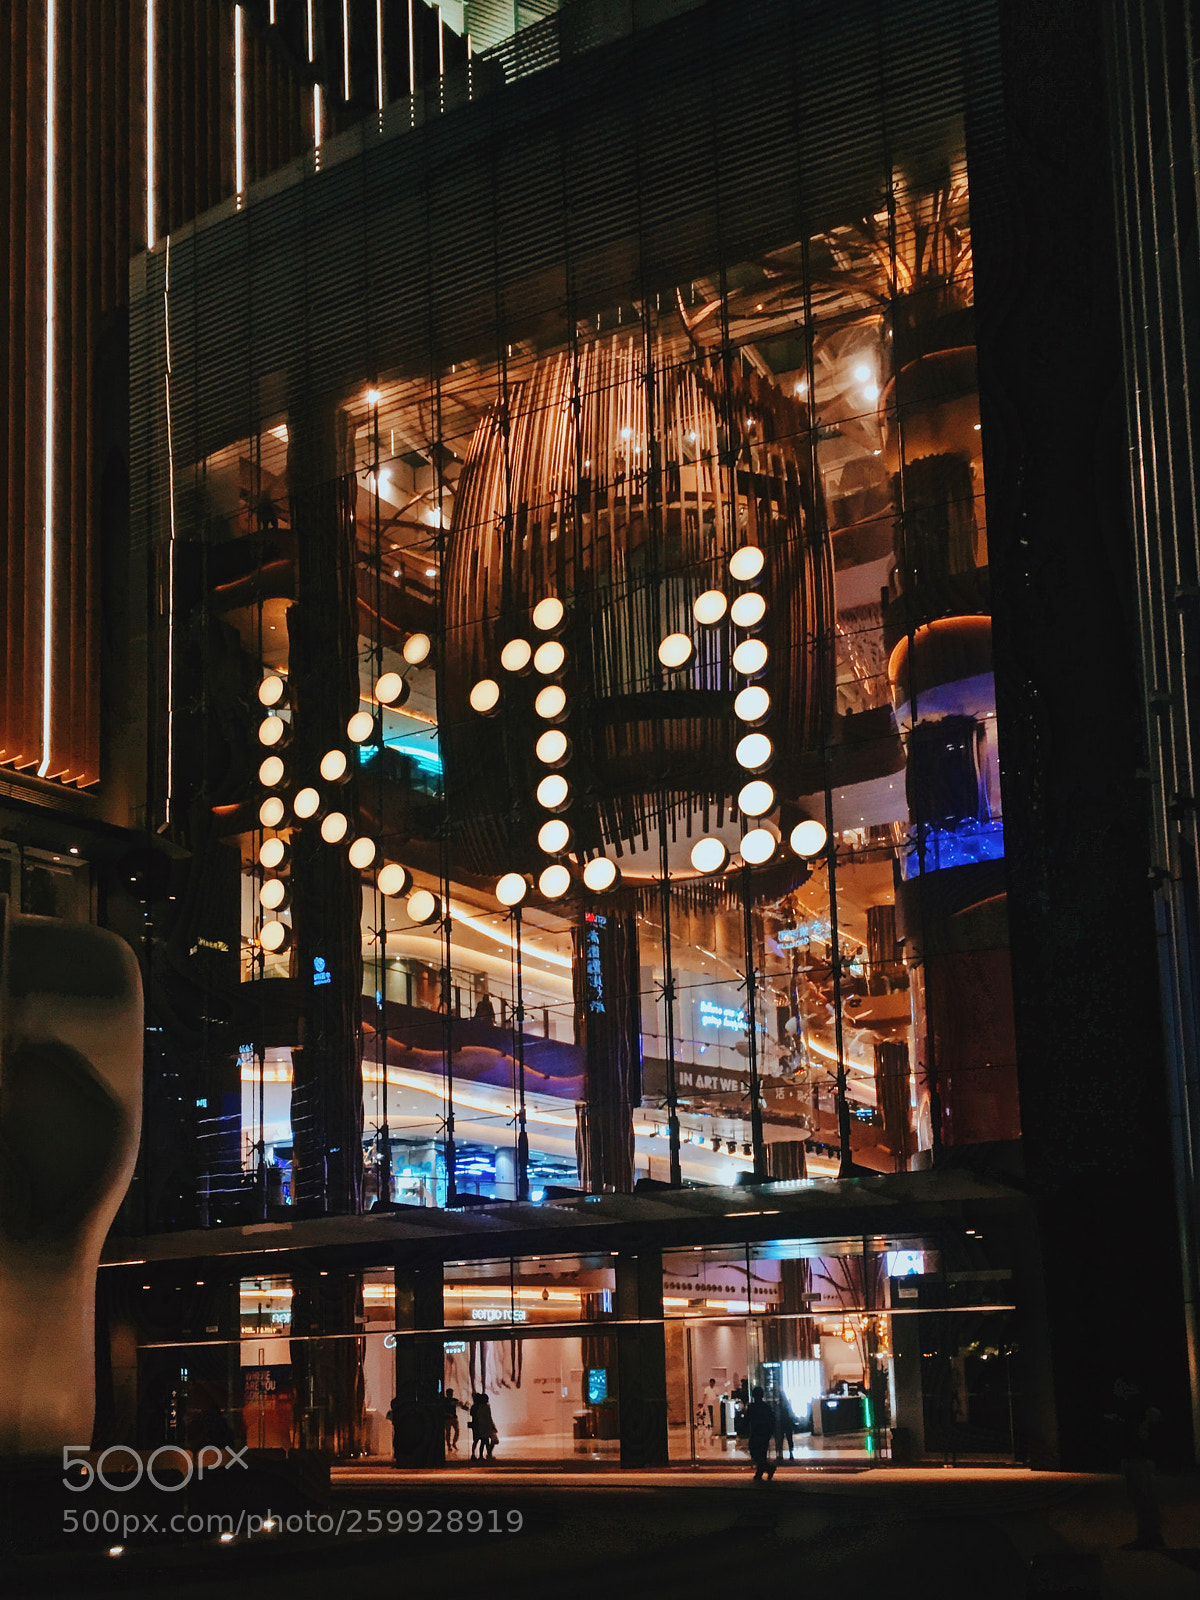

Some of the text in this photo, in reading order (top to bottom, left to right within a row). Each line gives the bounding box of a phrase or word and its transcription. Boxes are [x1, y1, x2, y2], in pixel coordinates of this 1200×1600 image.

[257, 545, 828, 954] K11
[679, 1071, 693, 1087] IN
[695, 1073, 718, 1091] ART
[719, 1077, 738, 1092] WE
